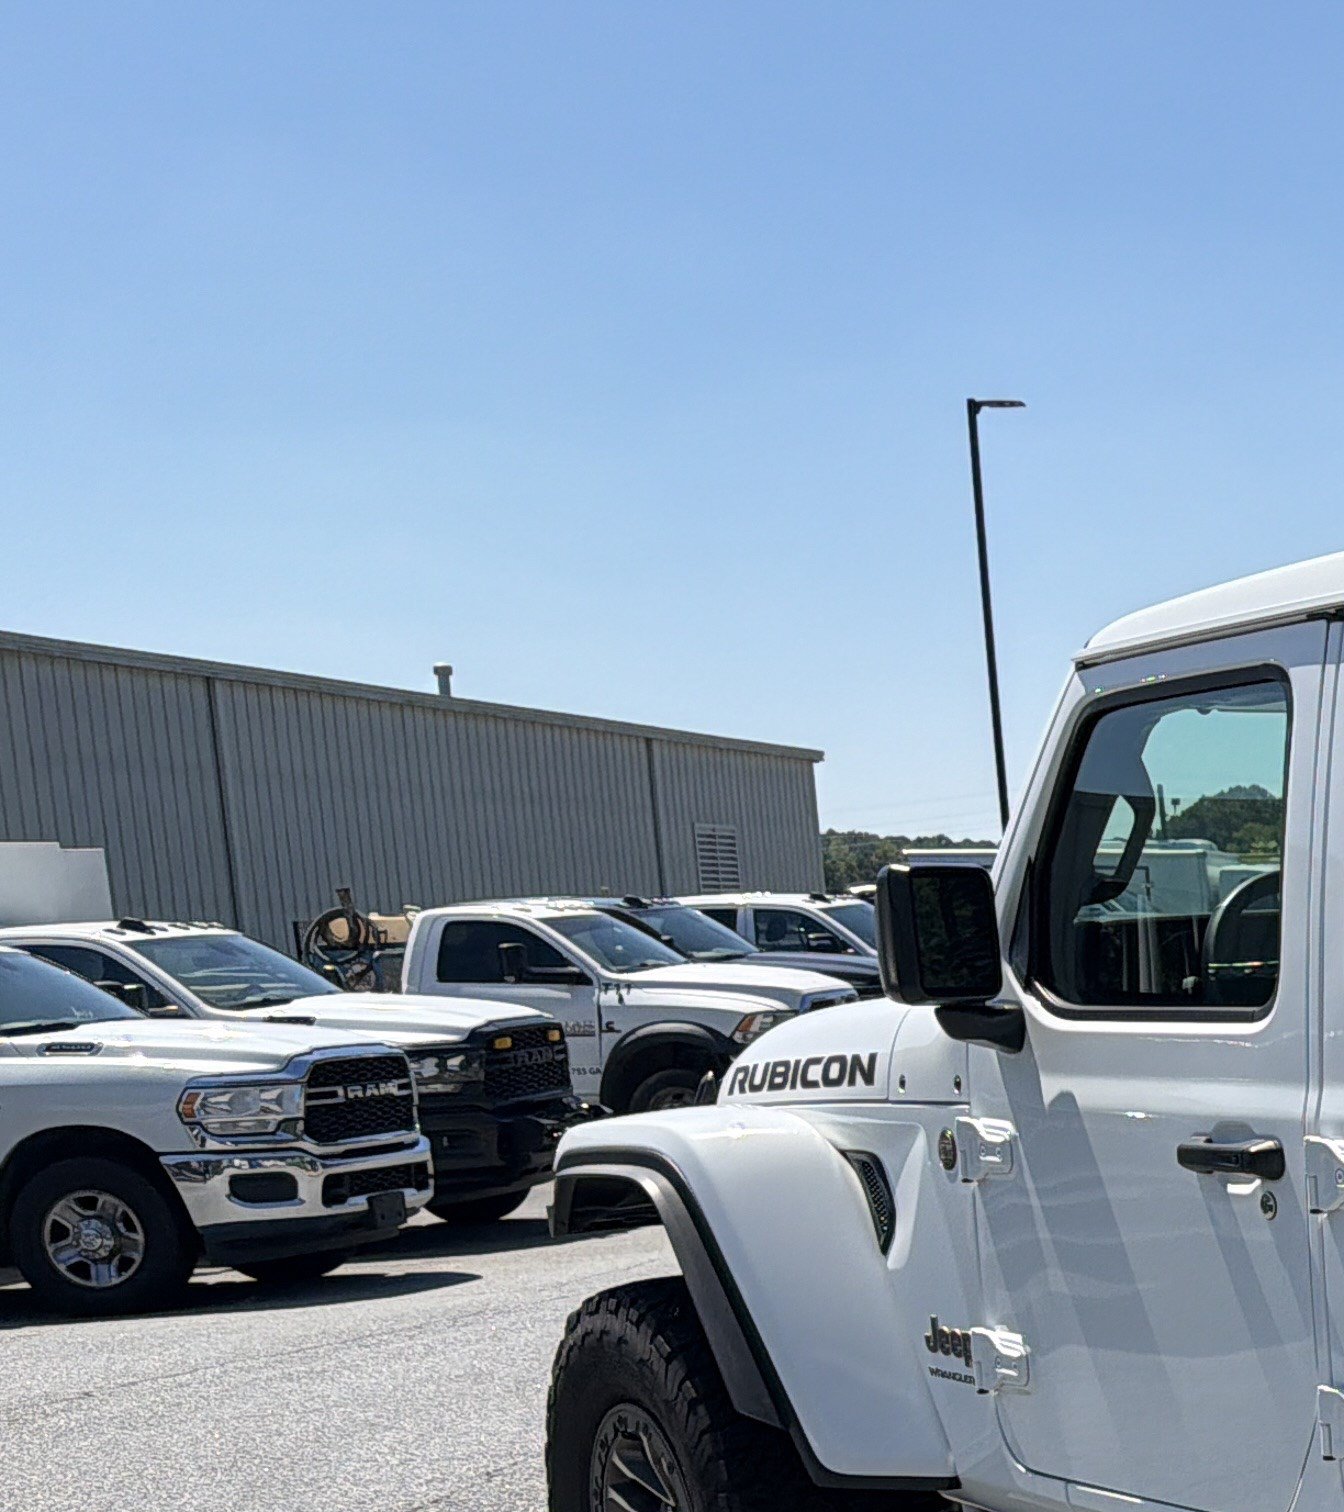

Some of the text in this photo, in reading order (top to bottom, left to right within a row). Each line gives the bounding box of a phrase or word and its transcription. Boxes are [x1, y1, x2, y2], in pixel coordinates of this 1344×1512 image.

[727, 1052, 878, 1096] RUBICON
[347, 1082, 399, 1099] RAM
[924, 1314, 974, 1368] Jeep
[928, 1367, 976, 1386] WRANGLER
